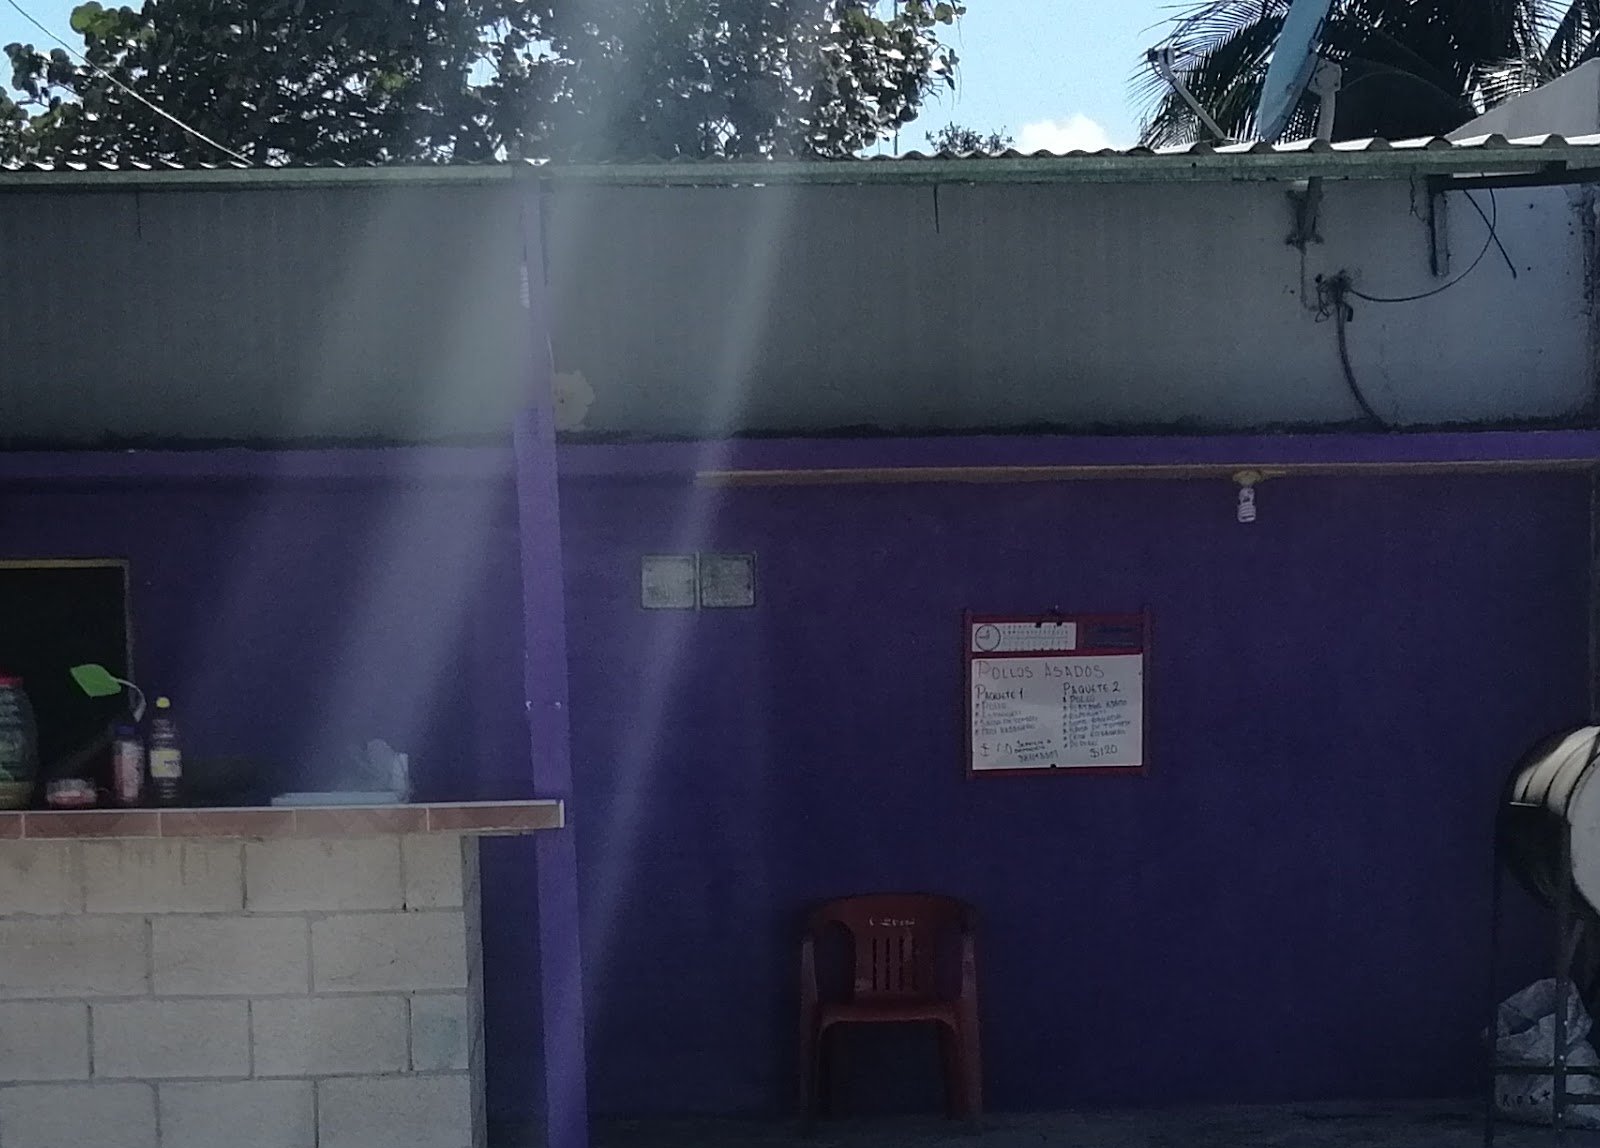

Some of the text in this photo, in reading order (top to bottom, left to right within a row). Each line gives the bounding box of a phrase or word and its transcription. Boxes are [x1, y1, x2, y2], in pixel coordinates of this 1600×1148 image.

[975, 660, 1105, 680] POLLOS ASADOS
[974, 684, 1016, 700] PAQUETE
[1063, 681, 1120, 695] PAQUETE 2
